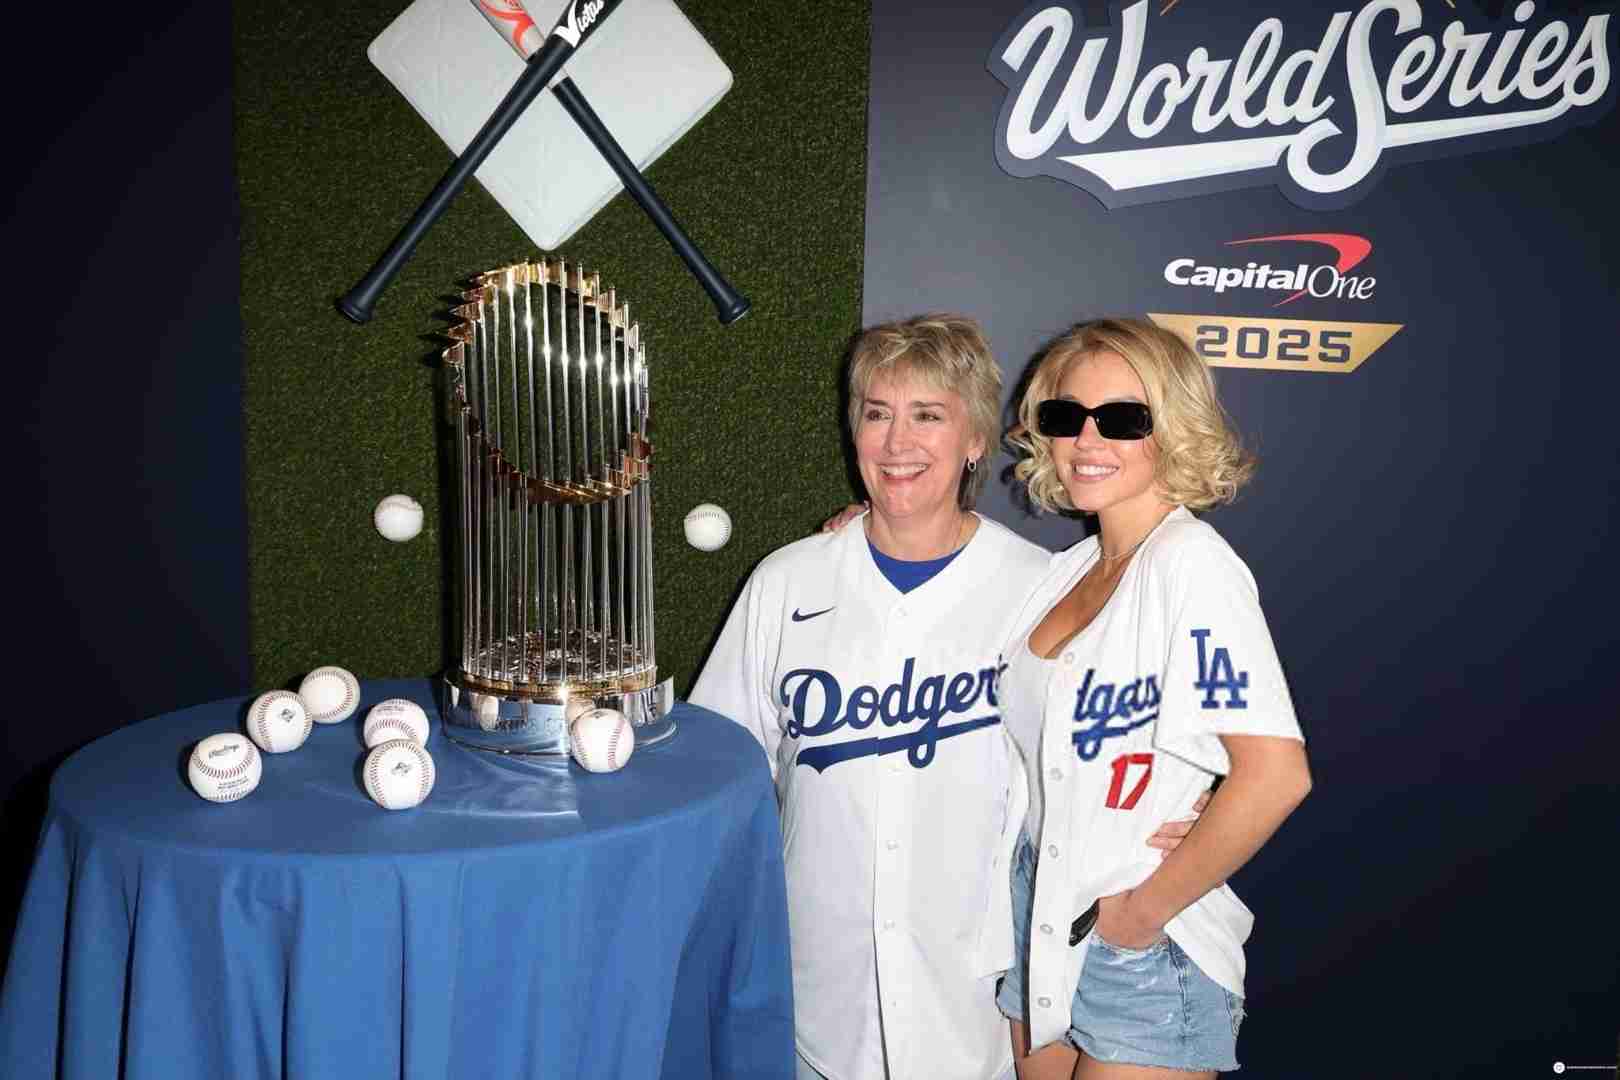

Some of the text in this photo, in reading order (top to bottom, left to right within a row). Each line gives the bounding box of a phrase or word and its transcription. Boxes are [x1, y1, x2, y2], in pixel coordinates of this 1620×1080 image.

[1001, 0, 1610, 193] World Series
[1196, 324, 1353, 364] 2025
[1190, 628, 1248, 709] LA
[1105, 753, 1154, 810] 17
